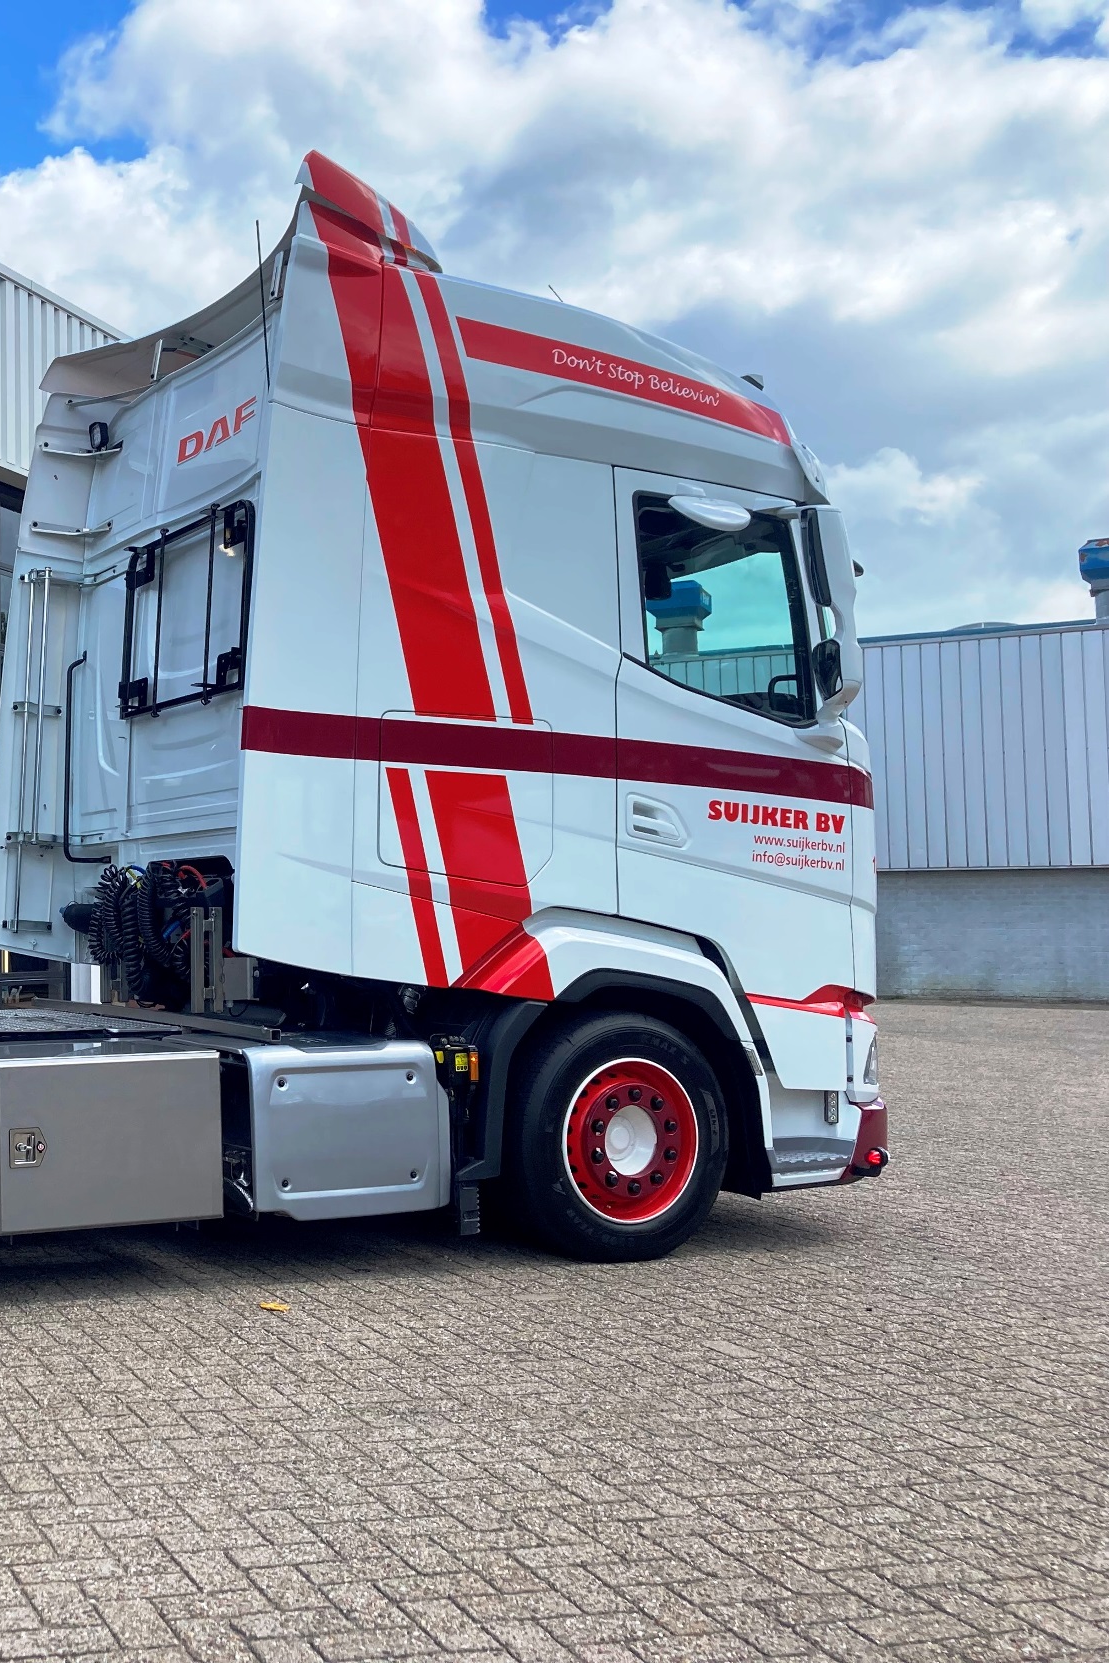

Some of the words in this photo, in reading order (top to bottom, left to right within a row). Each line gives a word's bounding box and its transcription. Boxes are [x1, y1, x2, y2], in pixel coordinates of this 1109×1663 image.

[608, 363, 644, 389] Stop
[177, 395, 257, 466] DAF
[707, 799, 809, 831] SUIJKER
[815, 812, 846, 834] BV
[753, 834, 846, 854] www.suijkerbv.nl
[752, 849, 845, 871] info@suijkerbv.nl
